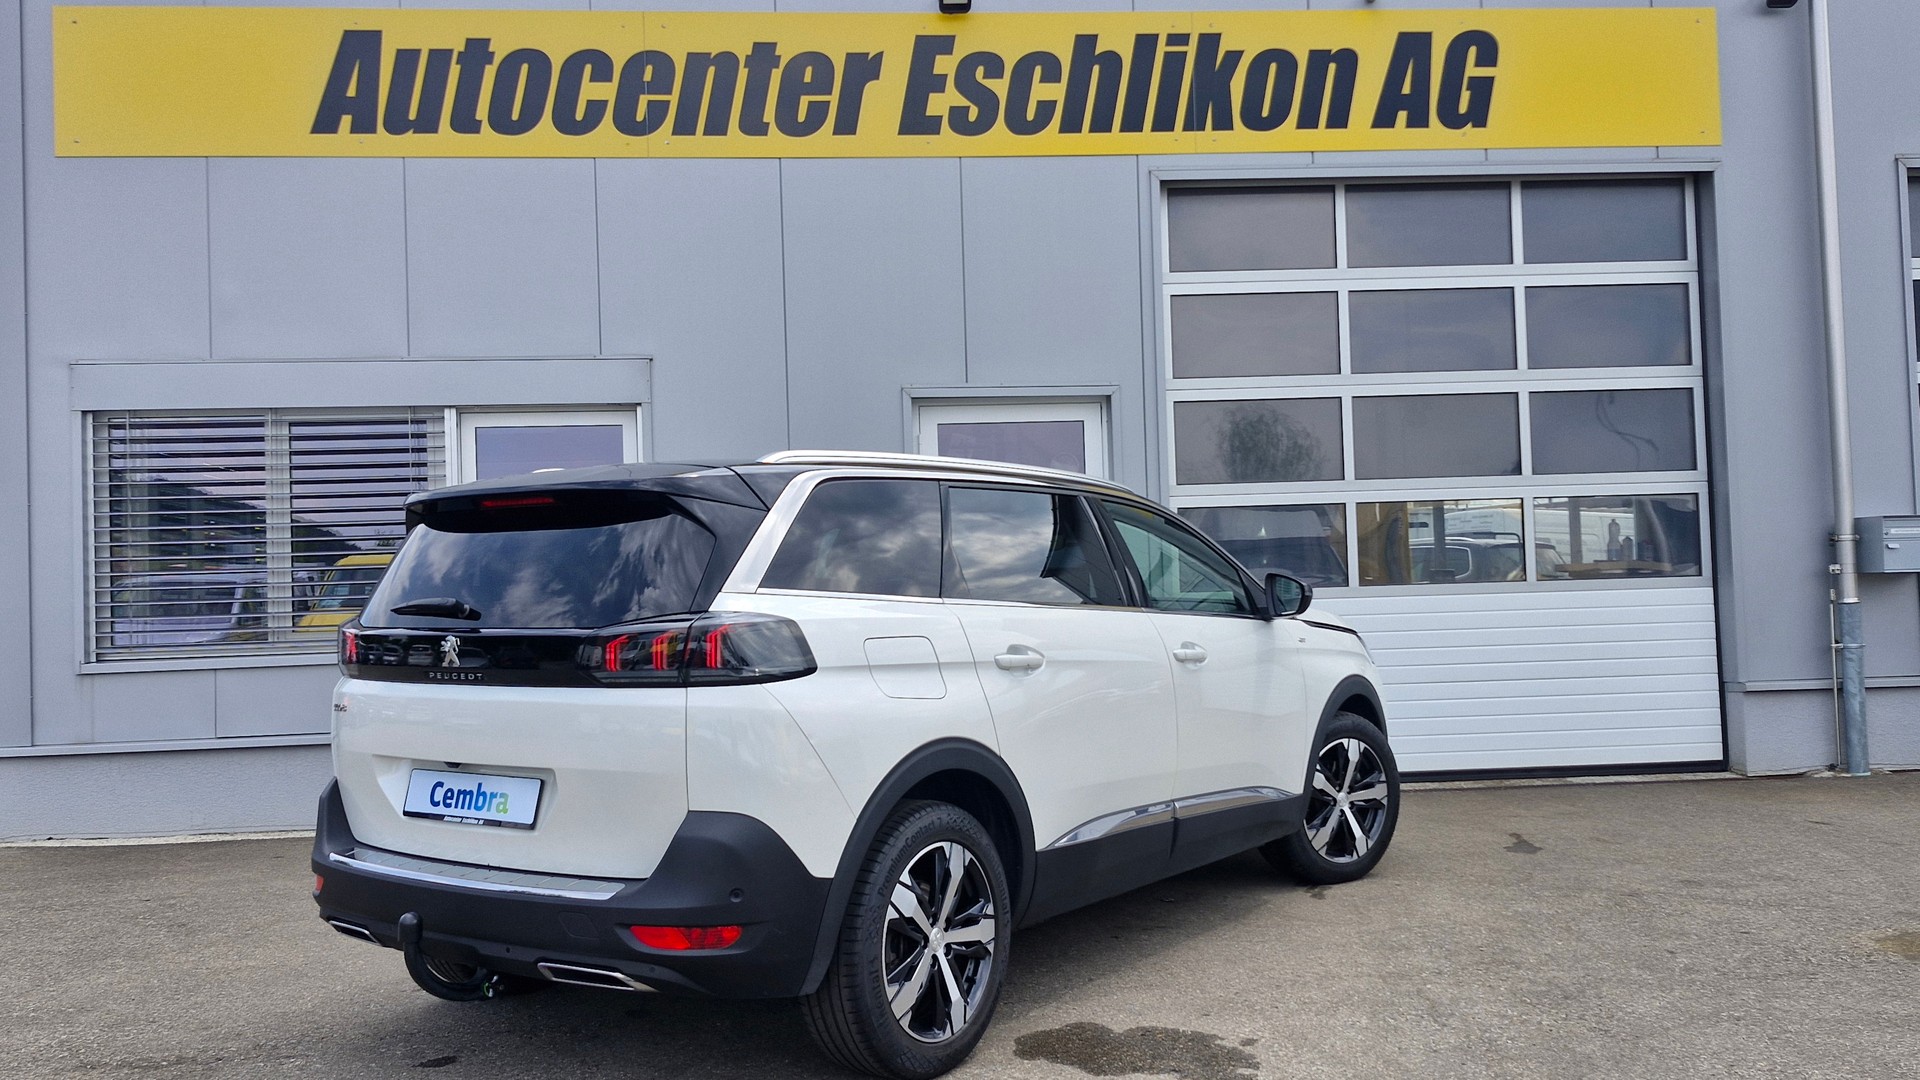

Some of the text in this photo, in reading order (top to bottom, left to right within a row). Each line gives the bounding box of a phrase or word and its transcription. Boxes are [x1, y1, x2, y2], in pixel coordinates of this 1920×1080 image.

[309, 29, 1499, 138] Autocenter Eschlikon AG
[430, 781, 509, 814] Cembra
